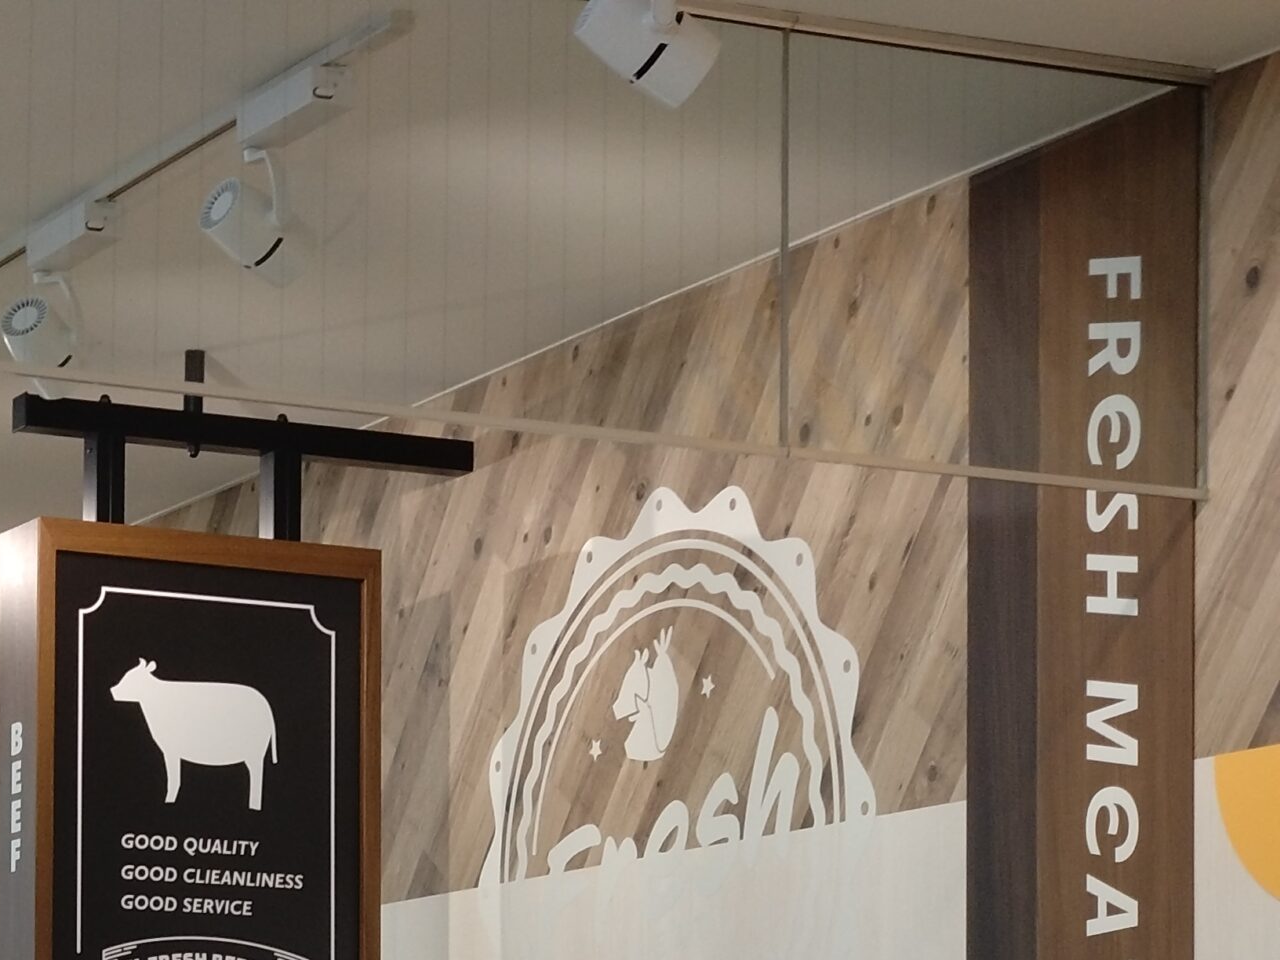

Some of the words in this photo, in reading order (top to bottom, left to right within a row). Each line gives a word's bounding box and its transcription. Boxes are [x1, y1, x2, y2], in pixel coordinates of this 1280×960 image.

[9, 722, 23, 873] BEEF
[120, 833, 178, 851] GOOD
[183, 837, 259, 856] QUALITY
[120, 864, 178, 882] GOOD
[120, 894, 178, 912] GOOD
[182, 897, 253, 916] SERVICE
